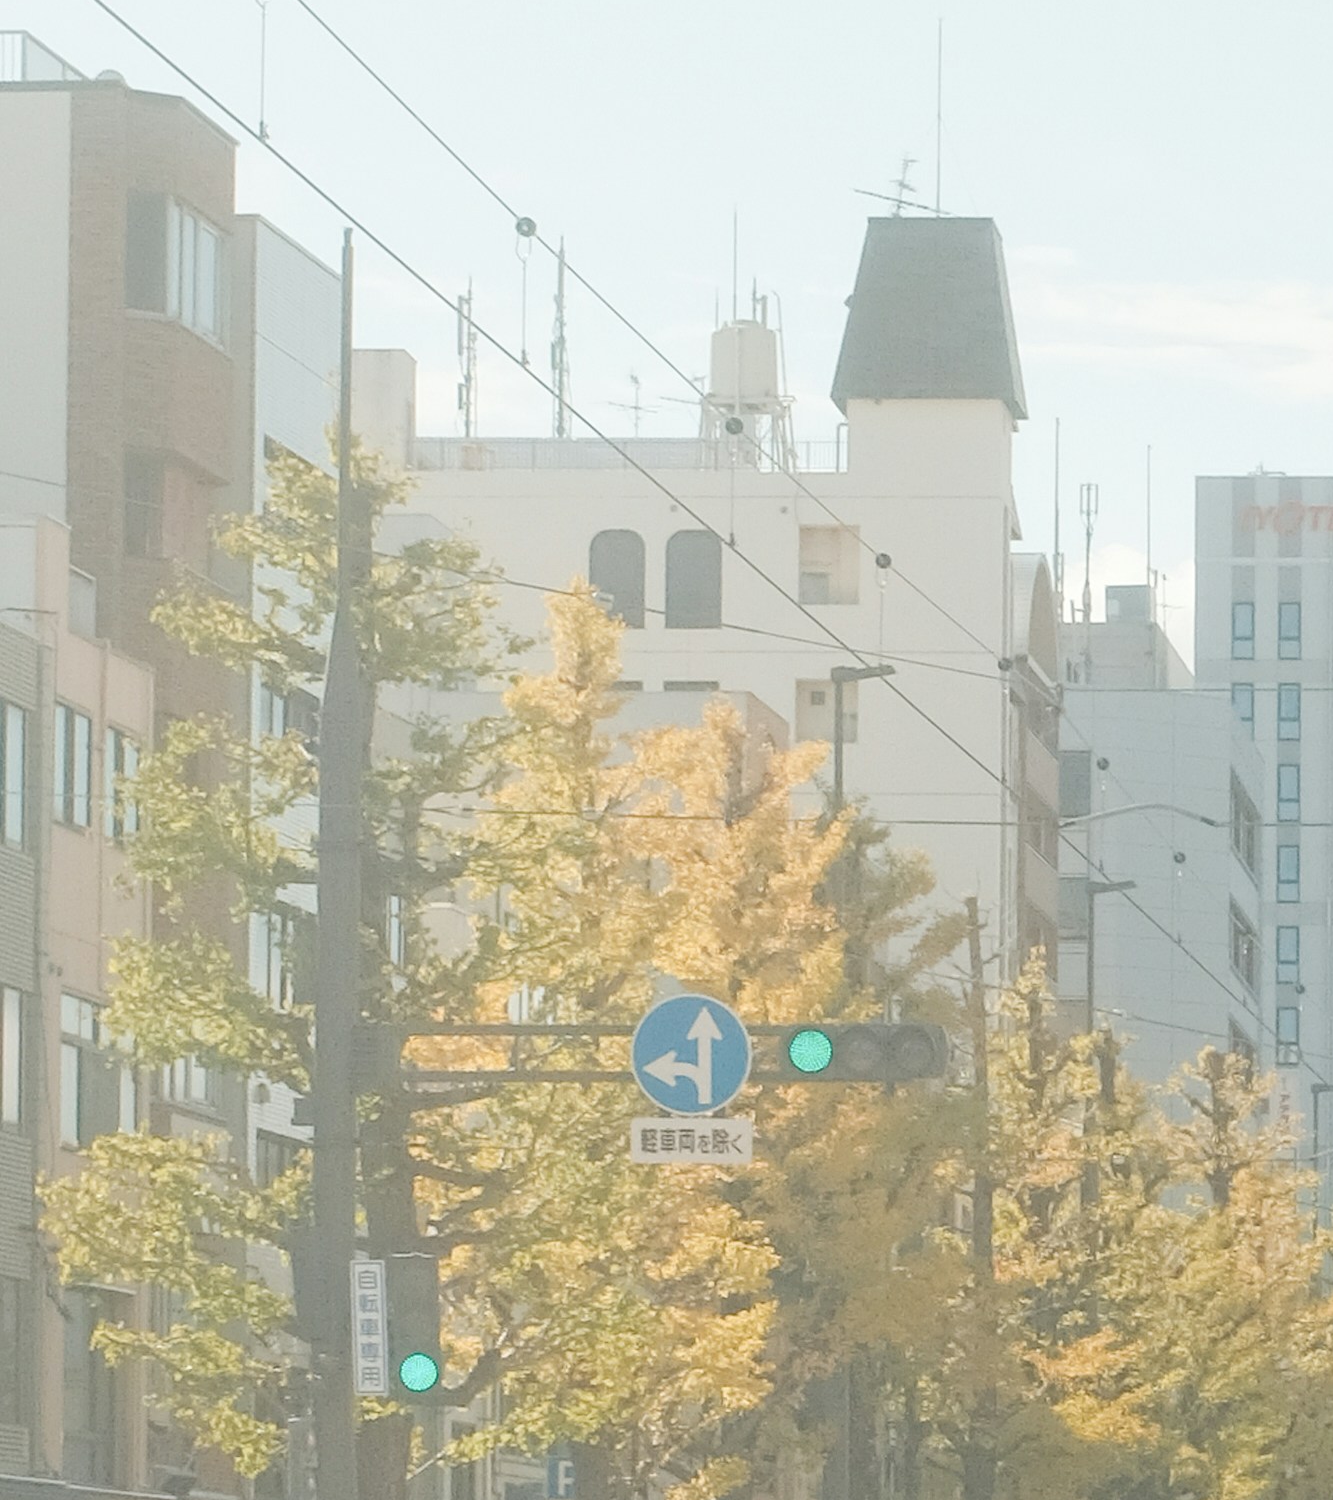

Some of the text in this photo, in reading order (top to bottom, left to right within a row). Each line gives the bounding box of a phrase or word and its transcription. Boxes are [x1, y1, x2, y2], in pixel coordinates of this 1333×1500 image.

[641, 1127, 743, 1155] 軽車両を除く
[358, 1269, 381, 1388] 自転車専用
